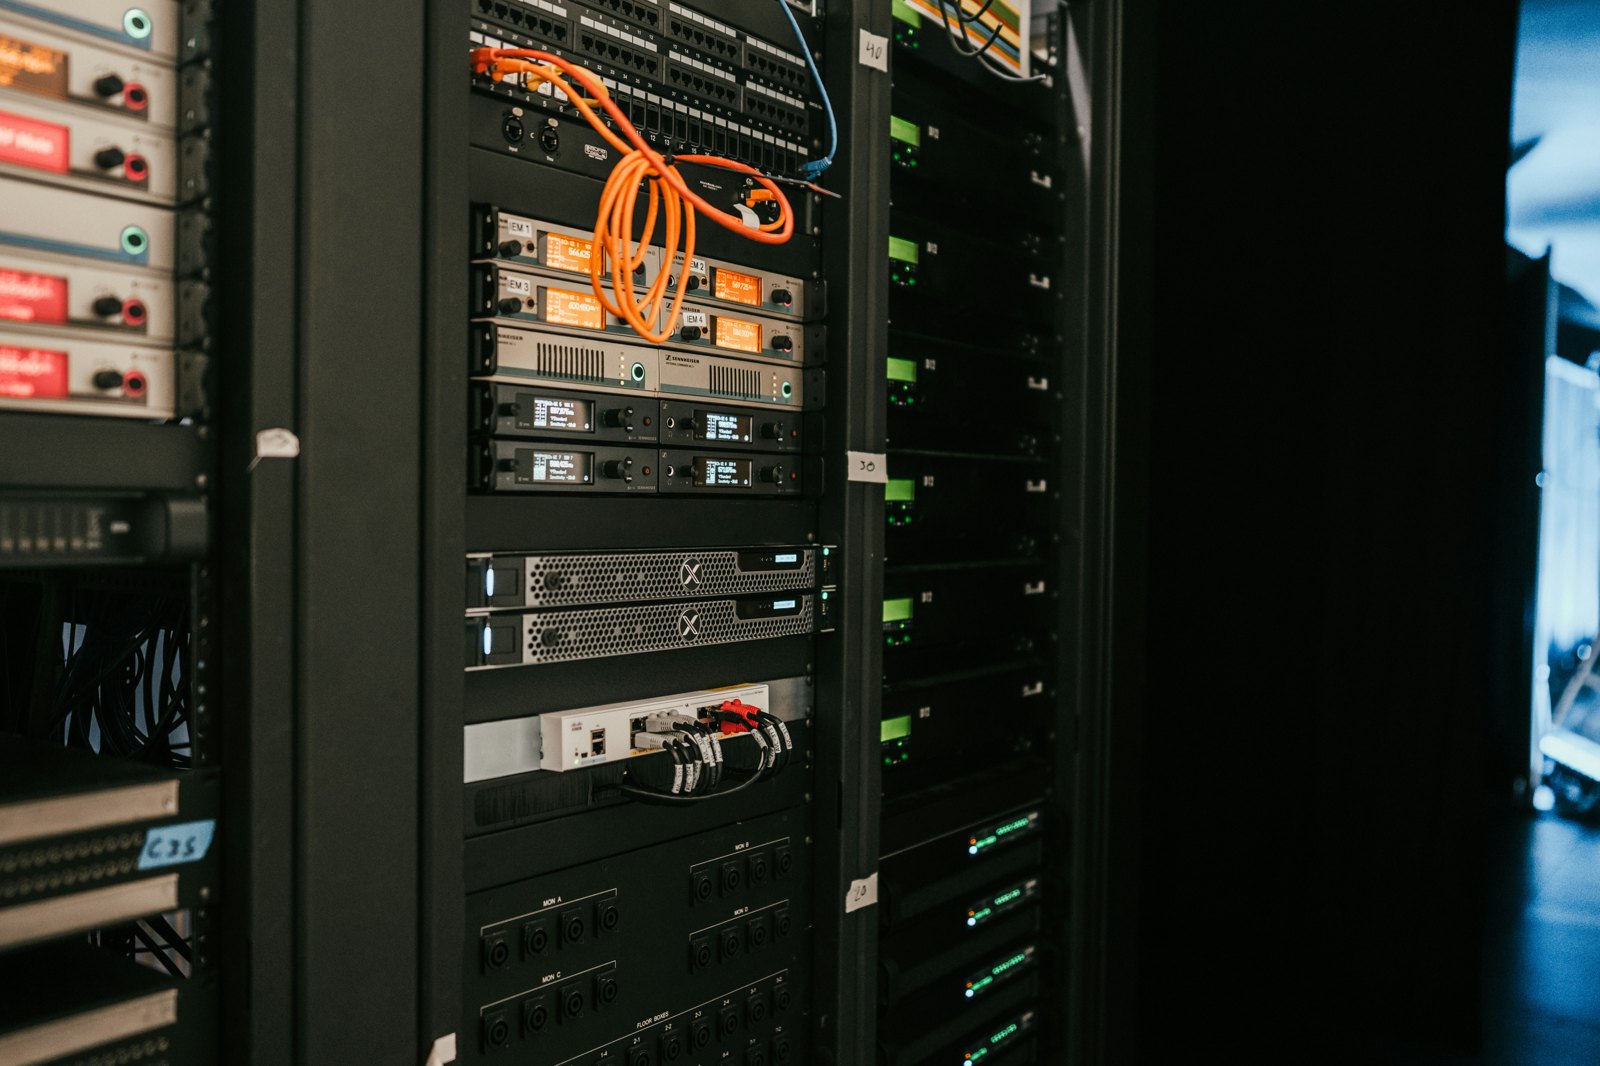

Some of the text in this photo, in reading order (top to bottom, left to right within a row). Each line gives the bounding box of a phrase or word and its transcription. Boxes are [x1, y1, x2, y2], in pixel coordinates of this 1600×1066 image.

[866, 41, 882, 60] 40
[524, 282, 529, 292] 3
[687, 315, 698, 323] IEM
[860, 460, 875, 472] 30
[543, 898, 555, 907] MON
[542, 975, 555, 983] MON
[637, 1011, 669, 1028] FLOOR BOXES
